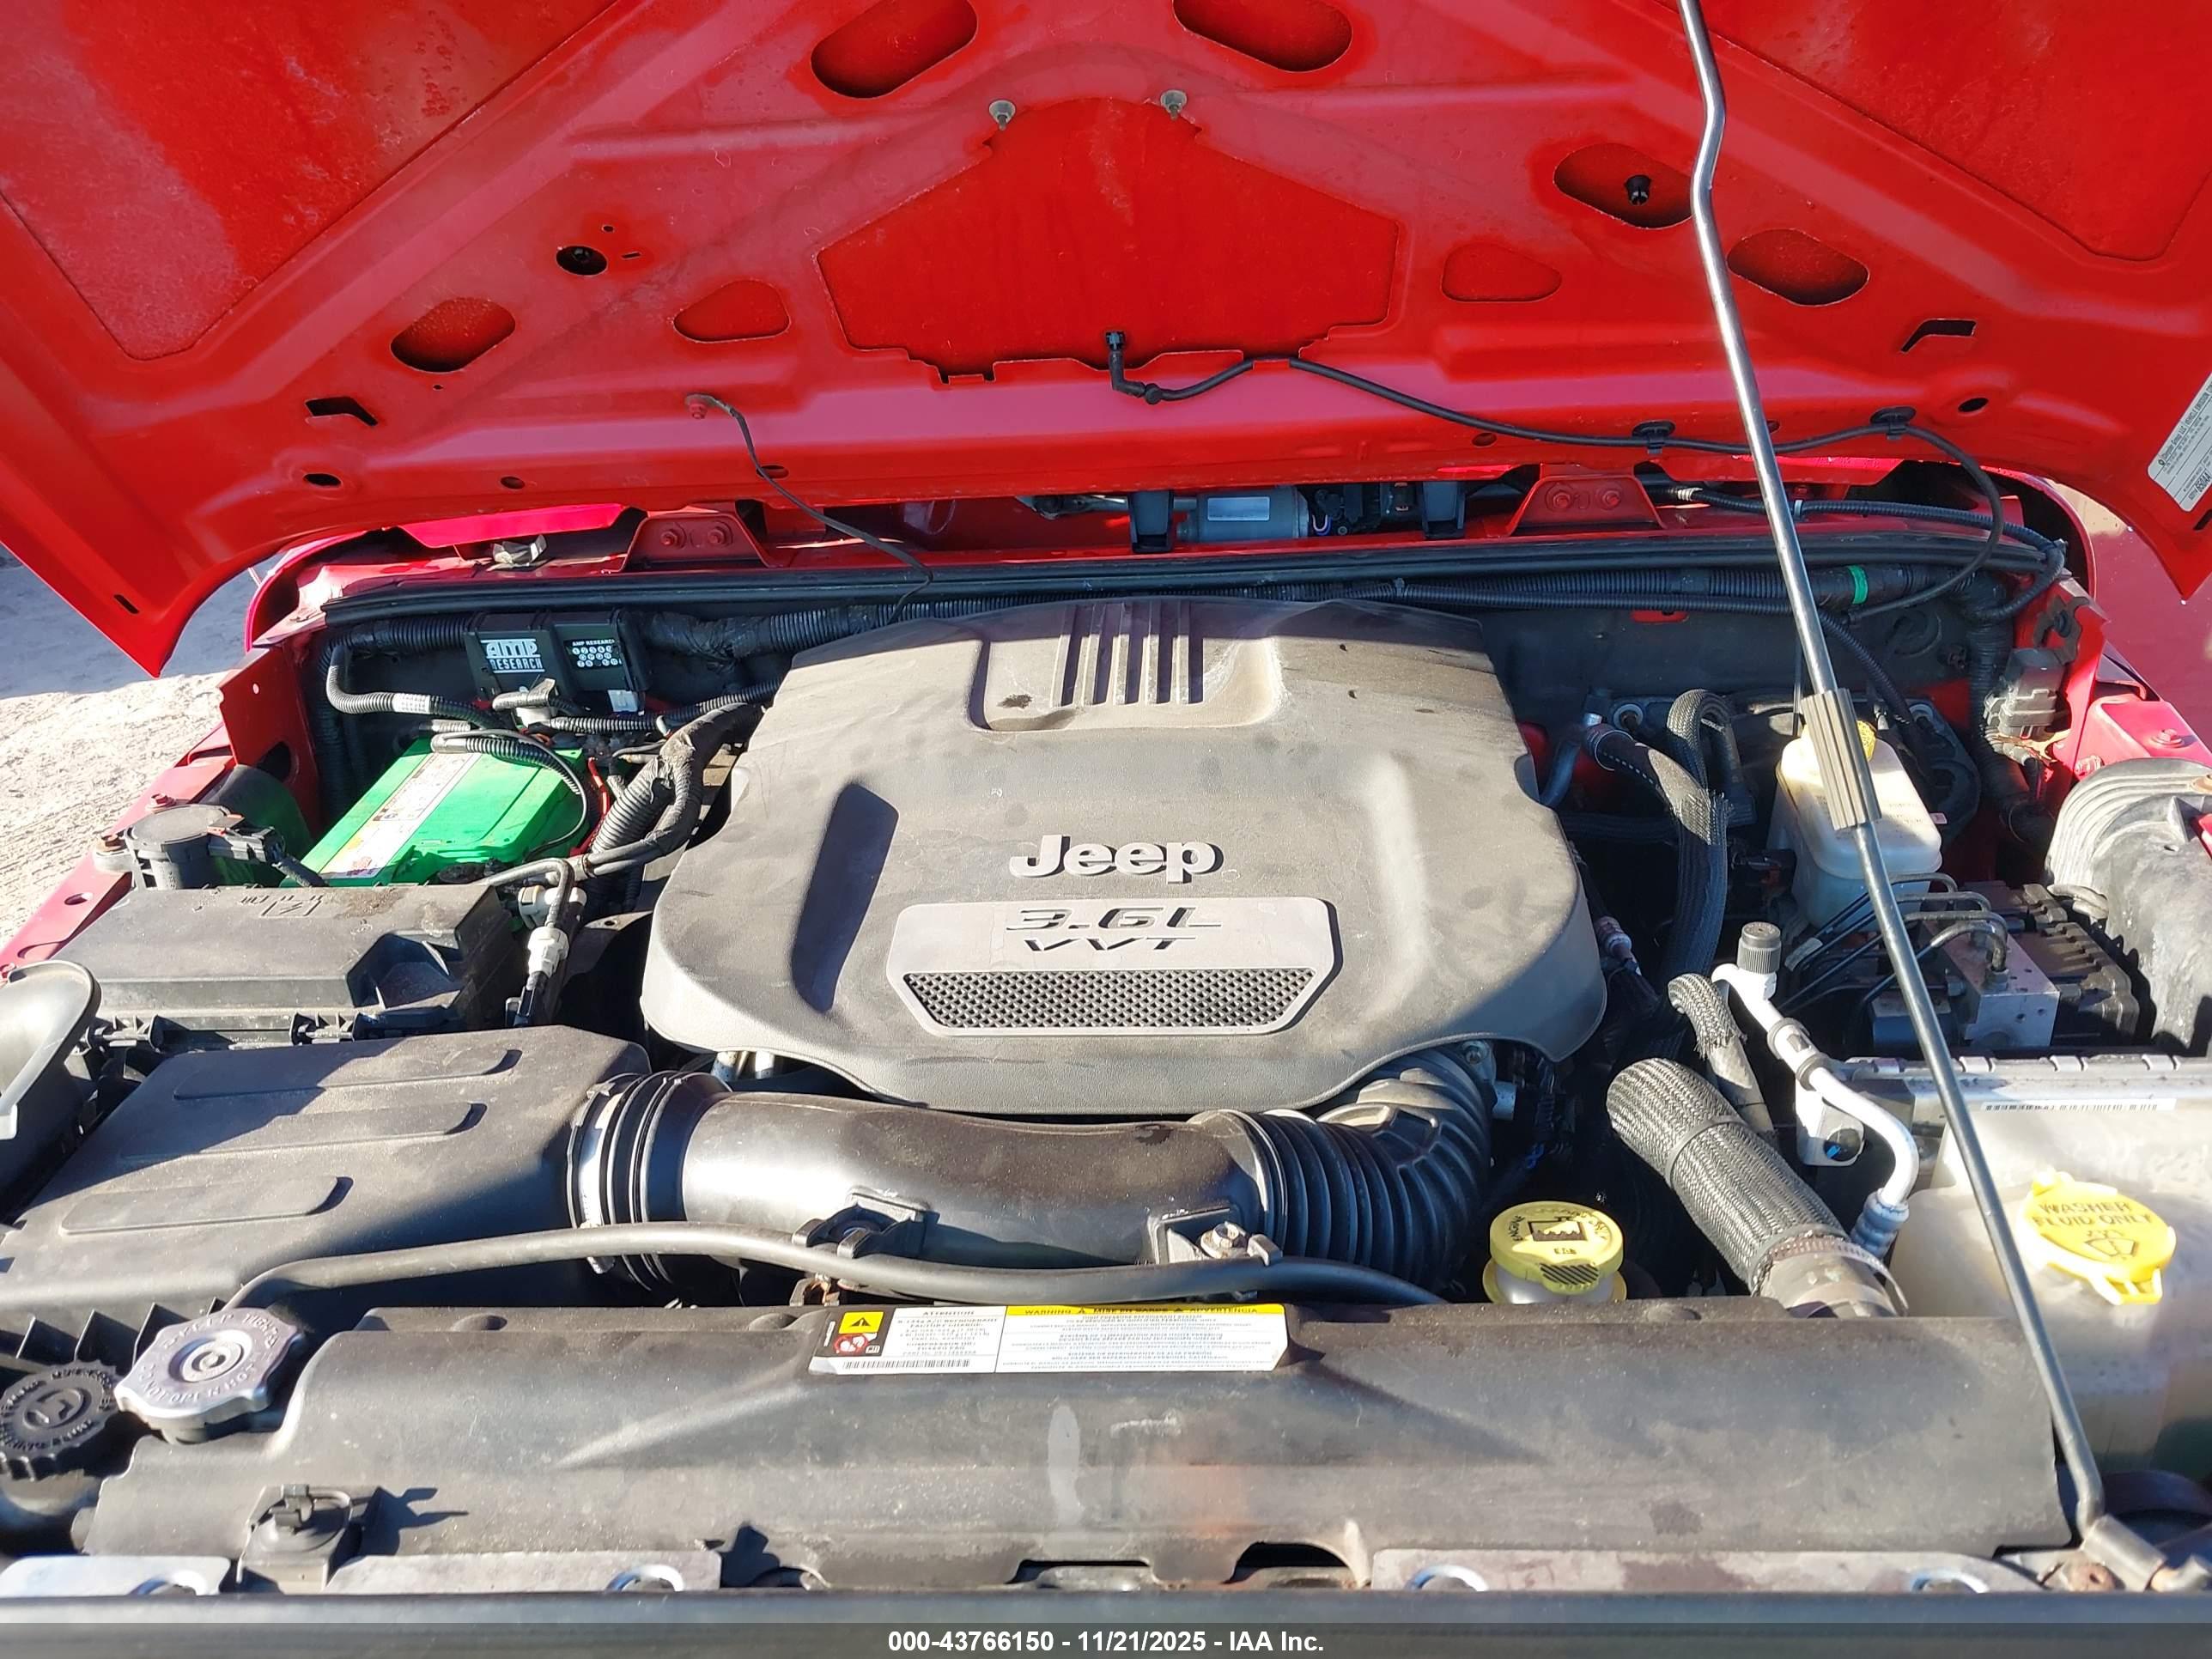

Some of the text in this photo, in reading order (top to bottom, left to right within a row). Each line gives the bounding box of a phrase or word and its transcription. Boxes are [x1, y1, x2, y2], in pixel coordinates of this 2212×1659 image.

[486, 640, 538, 658] AMP
[489, 658, 544, 670] RESEARCH
[1009, 835, 1224, 884] Jeep
[1006, 907, 1222, 930] 3.6L
[1024, 937, 1196, 952] VVT
[2039, 1201, 2132, 1214] WASHER
[2032, 1213, 2153, 1227] FLUID ONLY
